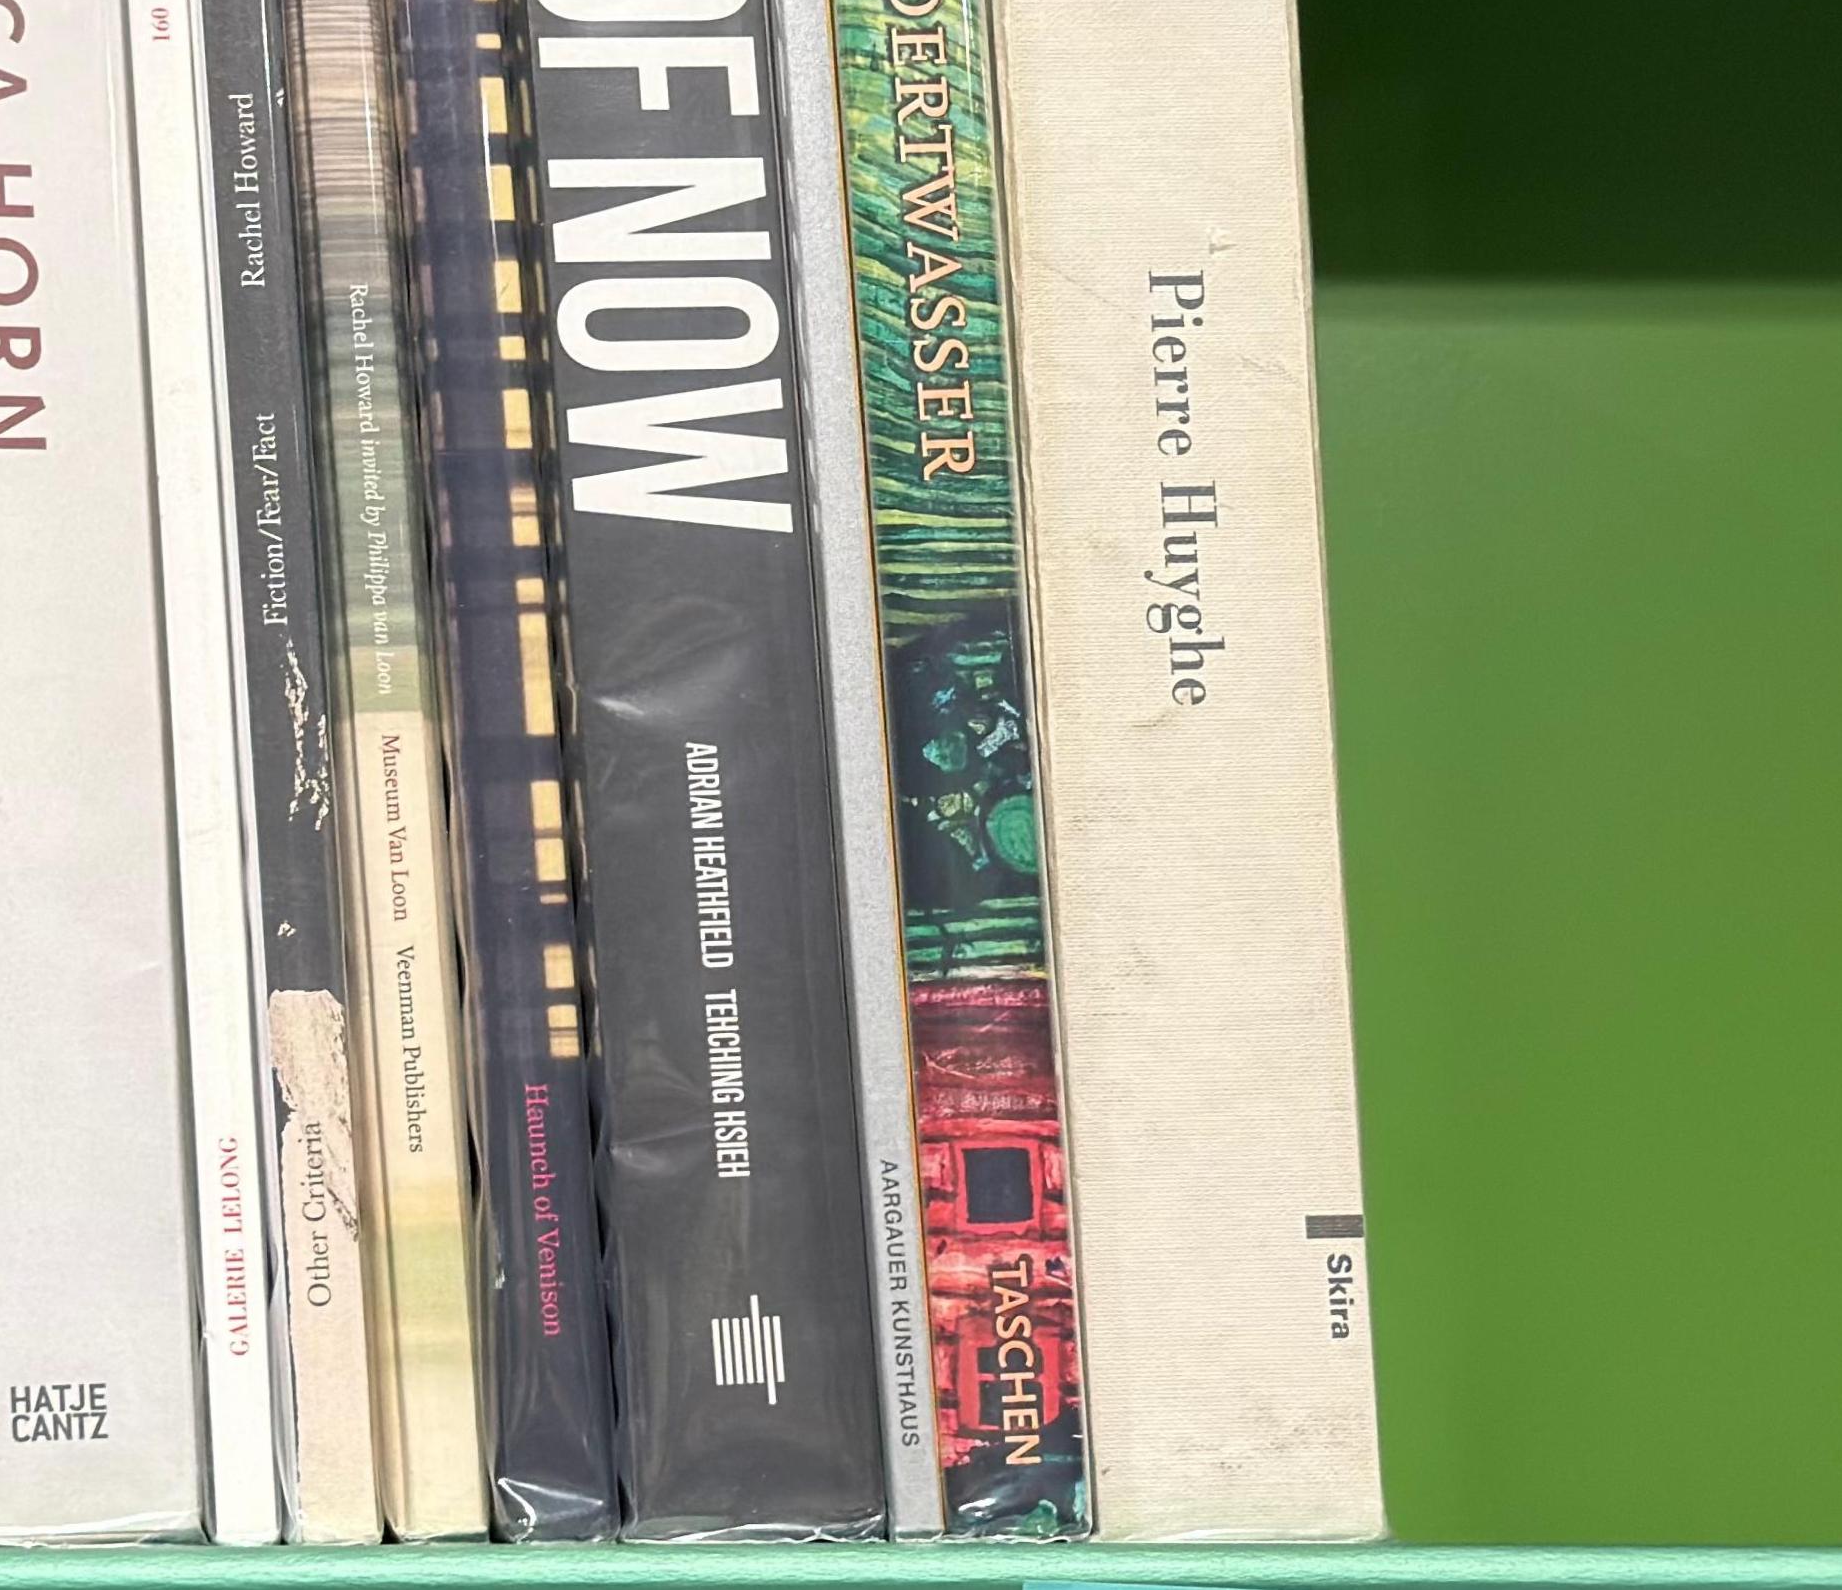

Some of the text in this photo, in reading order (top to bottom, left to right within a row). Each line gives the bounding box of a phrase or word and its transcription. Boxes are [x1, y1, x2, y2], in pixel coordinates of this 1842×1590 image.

[151, 7, 170, 42] 160
[228, 92, 265, 288] Rachel Howard
[548, 157, 794, 532] NOW
[252, 412, 288, 626] Fiction/Fear/Fact
[349, 283, 395, 695] Rachel Howard invited by Philippa van Loon
[1143, 269, 1226, 706] Pierre Huyghe
[381, 733, 428, 1153] Museum Van Loon Veenman Publishers
[685, 742, 751, 1178] ADRIAN HEATHFIELD TEHCHING HSIEH
[218, 1136, 250, 1357] GALERIE LELONG
[296, 1121, 333, 1308] Other Criteria
[524, 1083, 565, 1338] Haunch of Venison
[880, 1158, 921, 1448] AARGAUER KUNSTHAUS
[1326, 1253, 1353, 1340] Skira
[9, 1383, 108, 1413] HATJE
[11, 1411, 109, 1442] CANTZ
[991, 1260, 1044, 1467] TASCHEN
